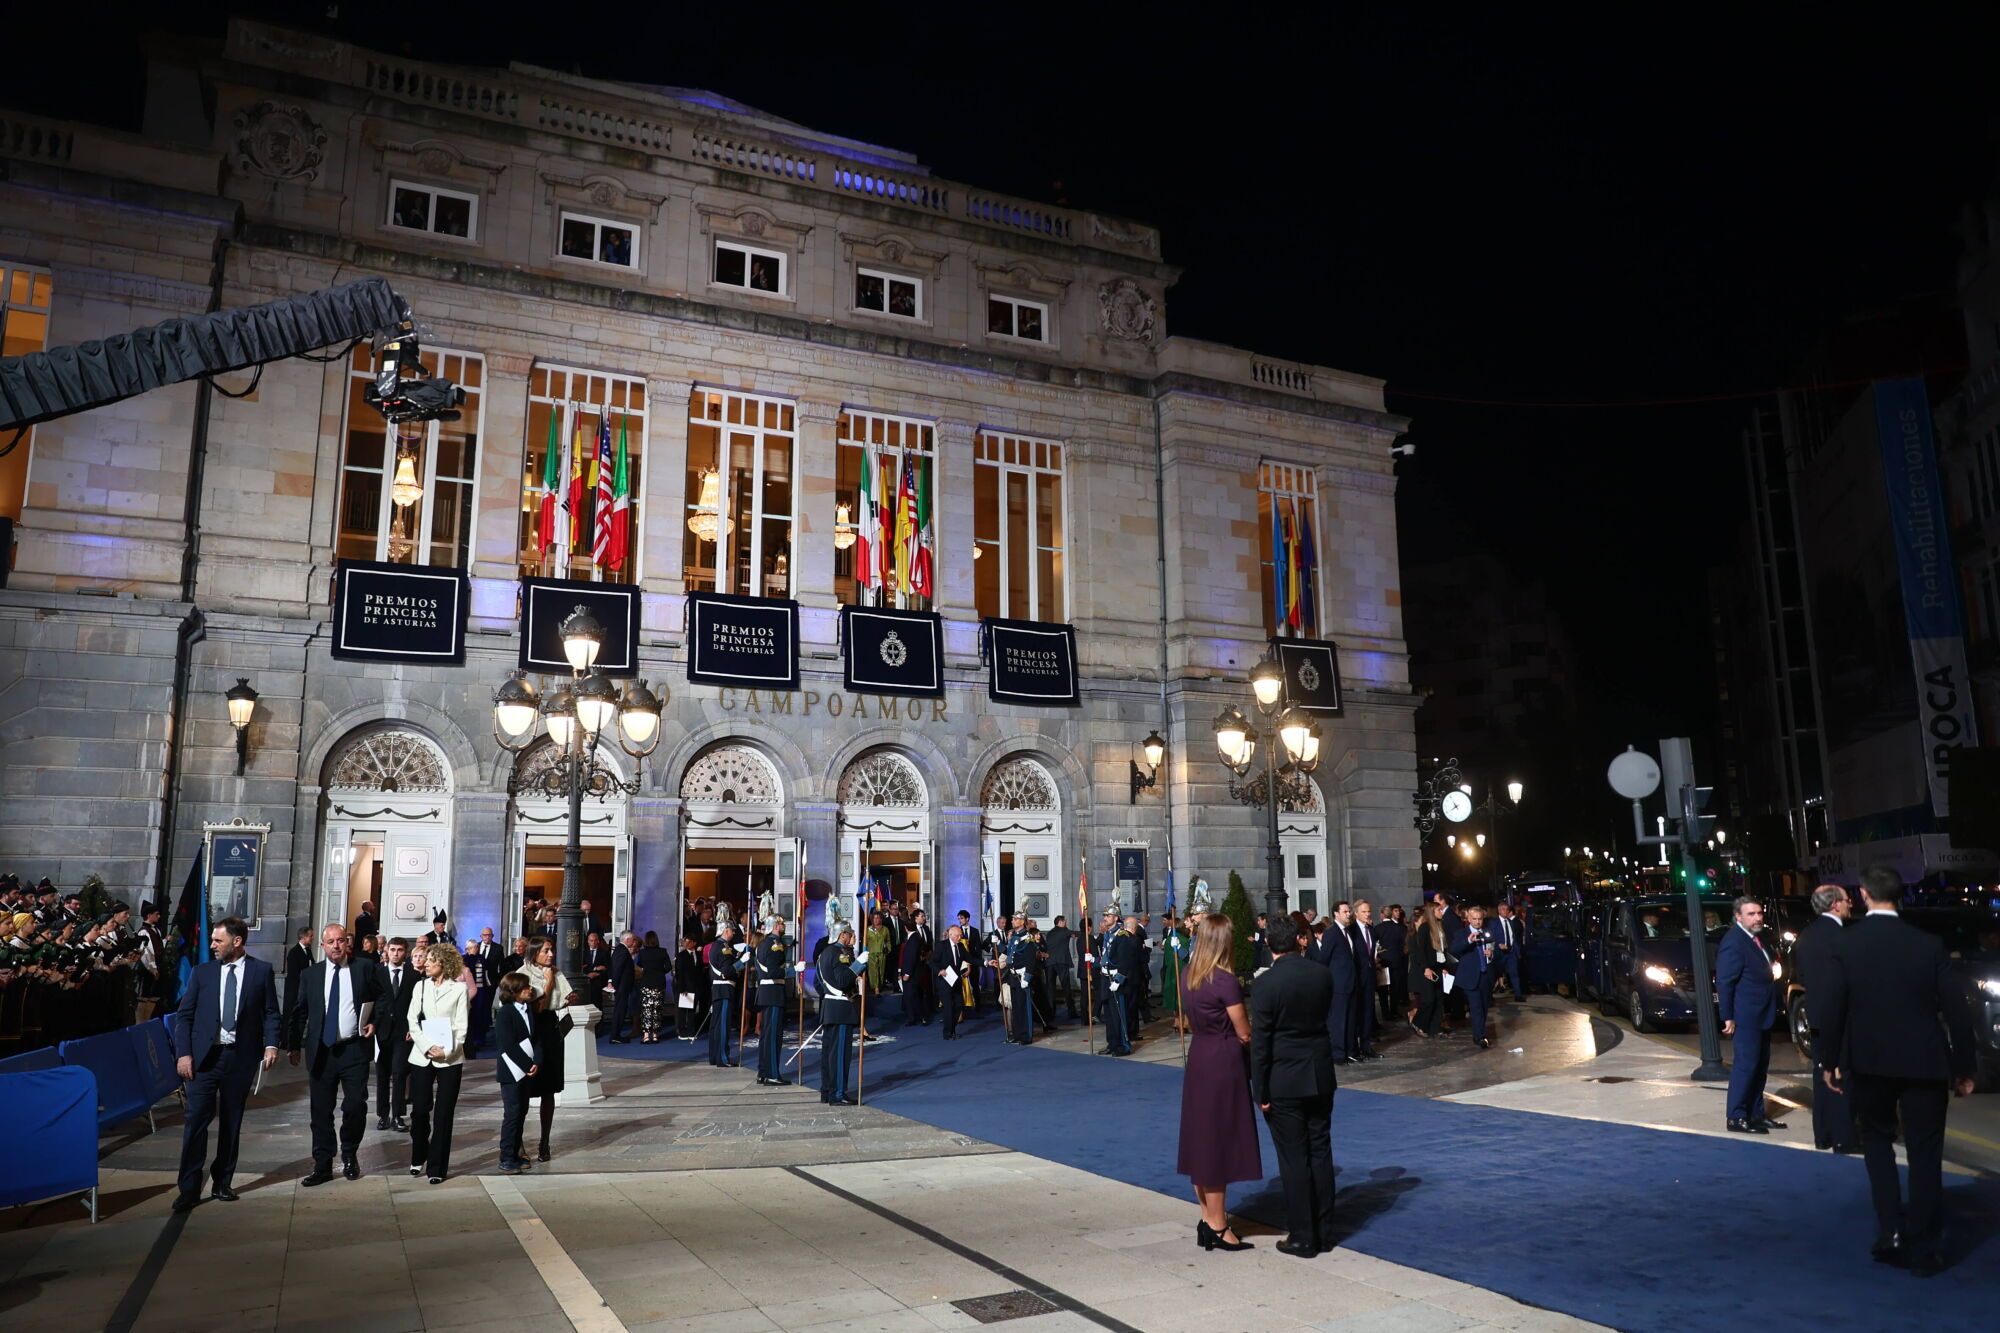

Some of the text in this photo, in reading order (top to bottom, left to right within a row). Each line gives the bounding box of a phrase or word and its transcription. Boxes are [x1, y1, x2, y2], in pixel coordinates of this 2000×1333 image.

[1899, 409, 1944, 609] Rehabilitaciones
[365, 594, 437, 608] PREMIOS
[364, 606, 436, 619] PRINCESA
[383, 618, 436, 627] ASTURIAS
[713, 623, 774, 636] PREMIOS
[713, 634, 774, 646] PRINCESA
[729, 646, 774, 655] ASTURIAS
[1006, 648, 1057, 659] PREMIOS
[1007, 657, 1058, 668] PRINCESA
[719, 687, 948, 722] CAMPOAMOR
